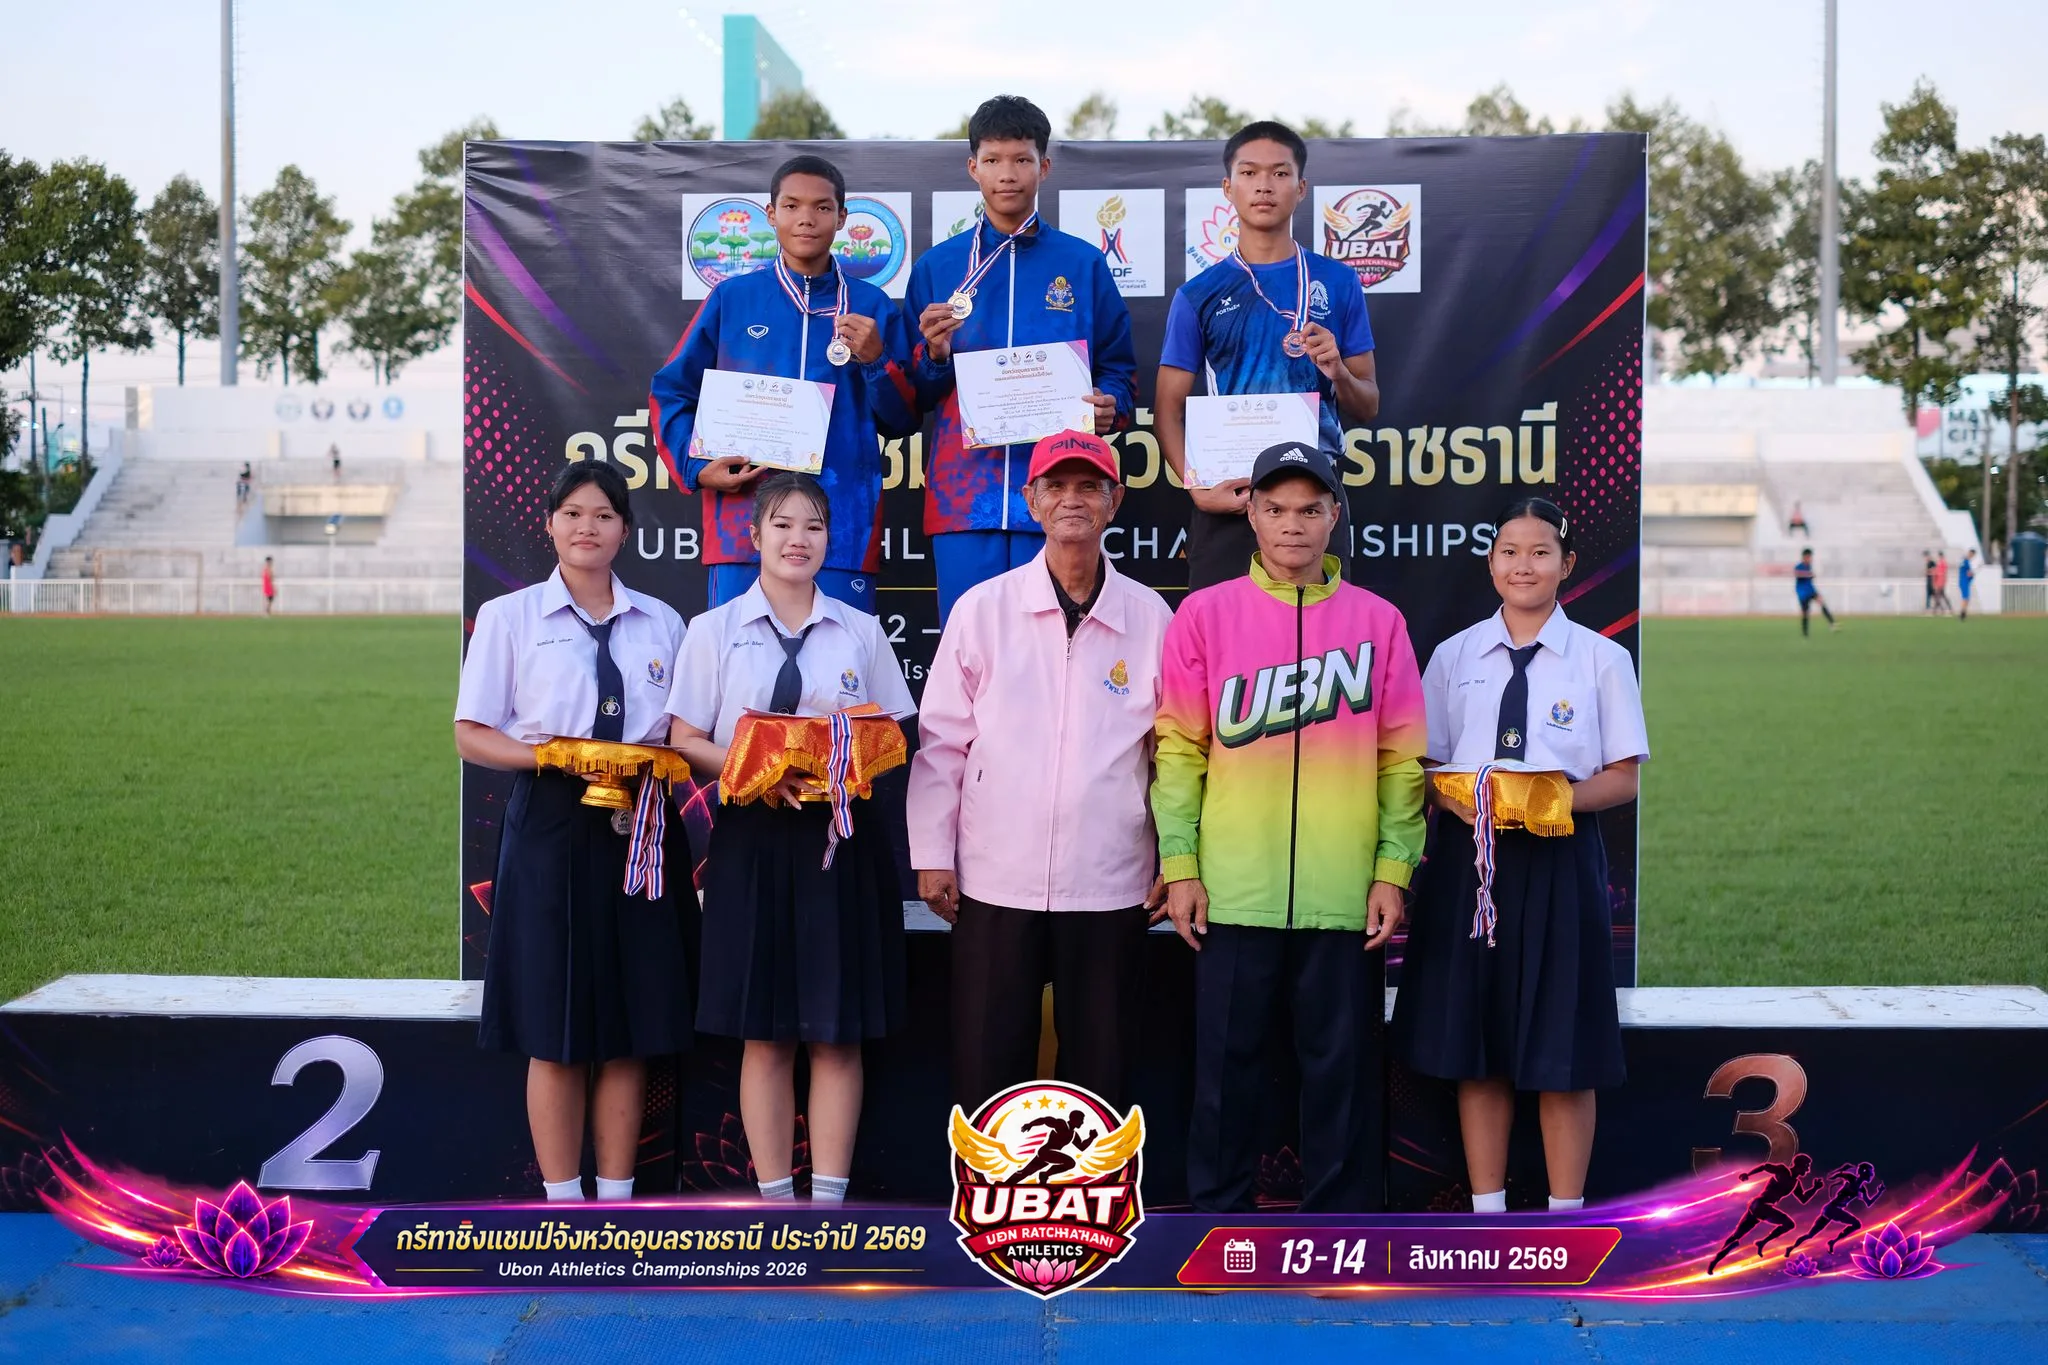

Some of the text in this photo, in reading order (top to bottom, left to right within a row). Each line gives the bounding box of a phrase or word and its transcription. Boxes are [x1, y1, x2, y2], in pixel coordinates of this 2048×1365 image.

[1331, 240, 1404, 259] UBAT
[1110, 267, 1132, 277] DF
[1050, 437, 1103, 455] PING
[1279, 454, 1308, 464] adidas
[1217, 641, 1374, 746] UBN
[257, 1034, 386, 1191] 2
[1692, 1053, 1808, 1175] 3
